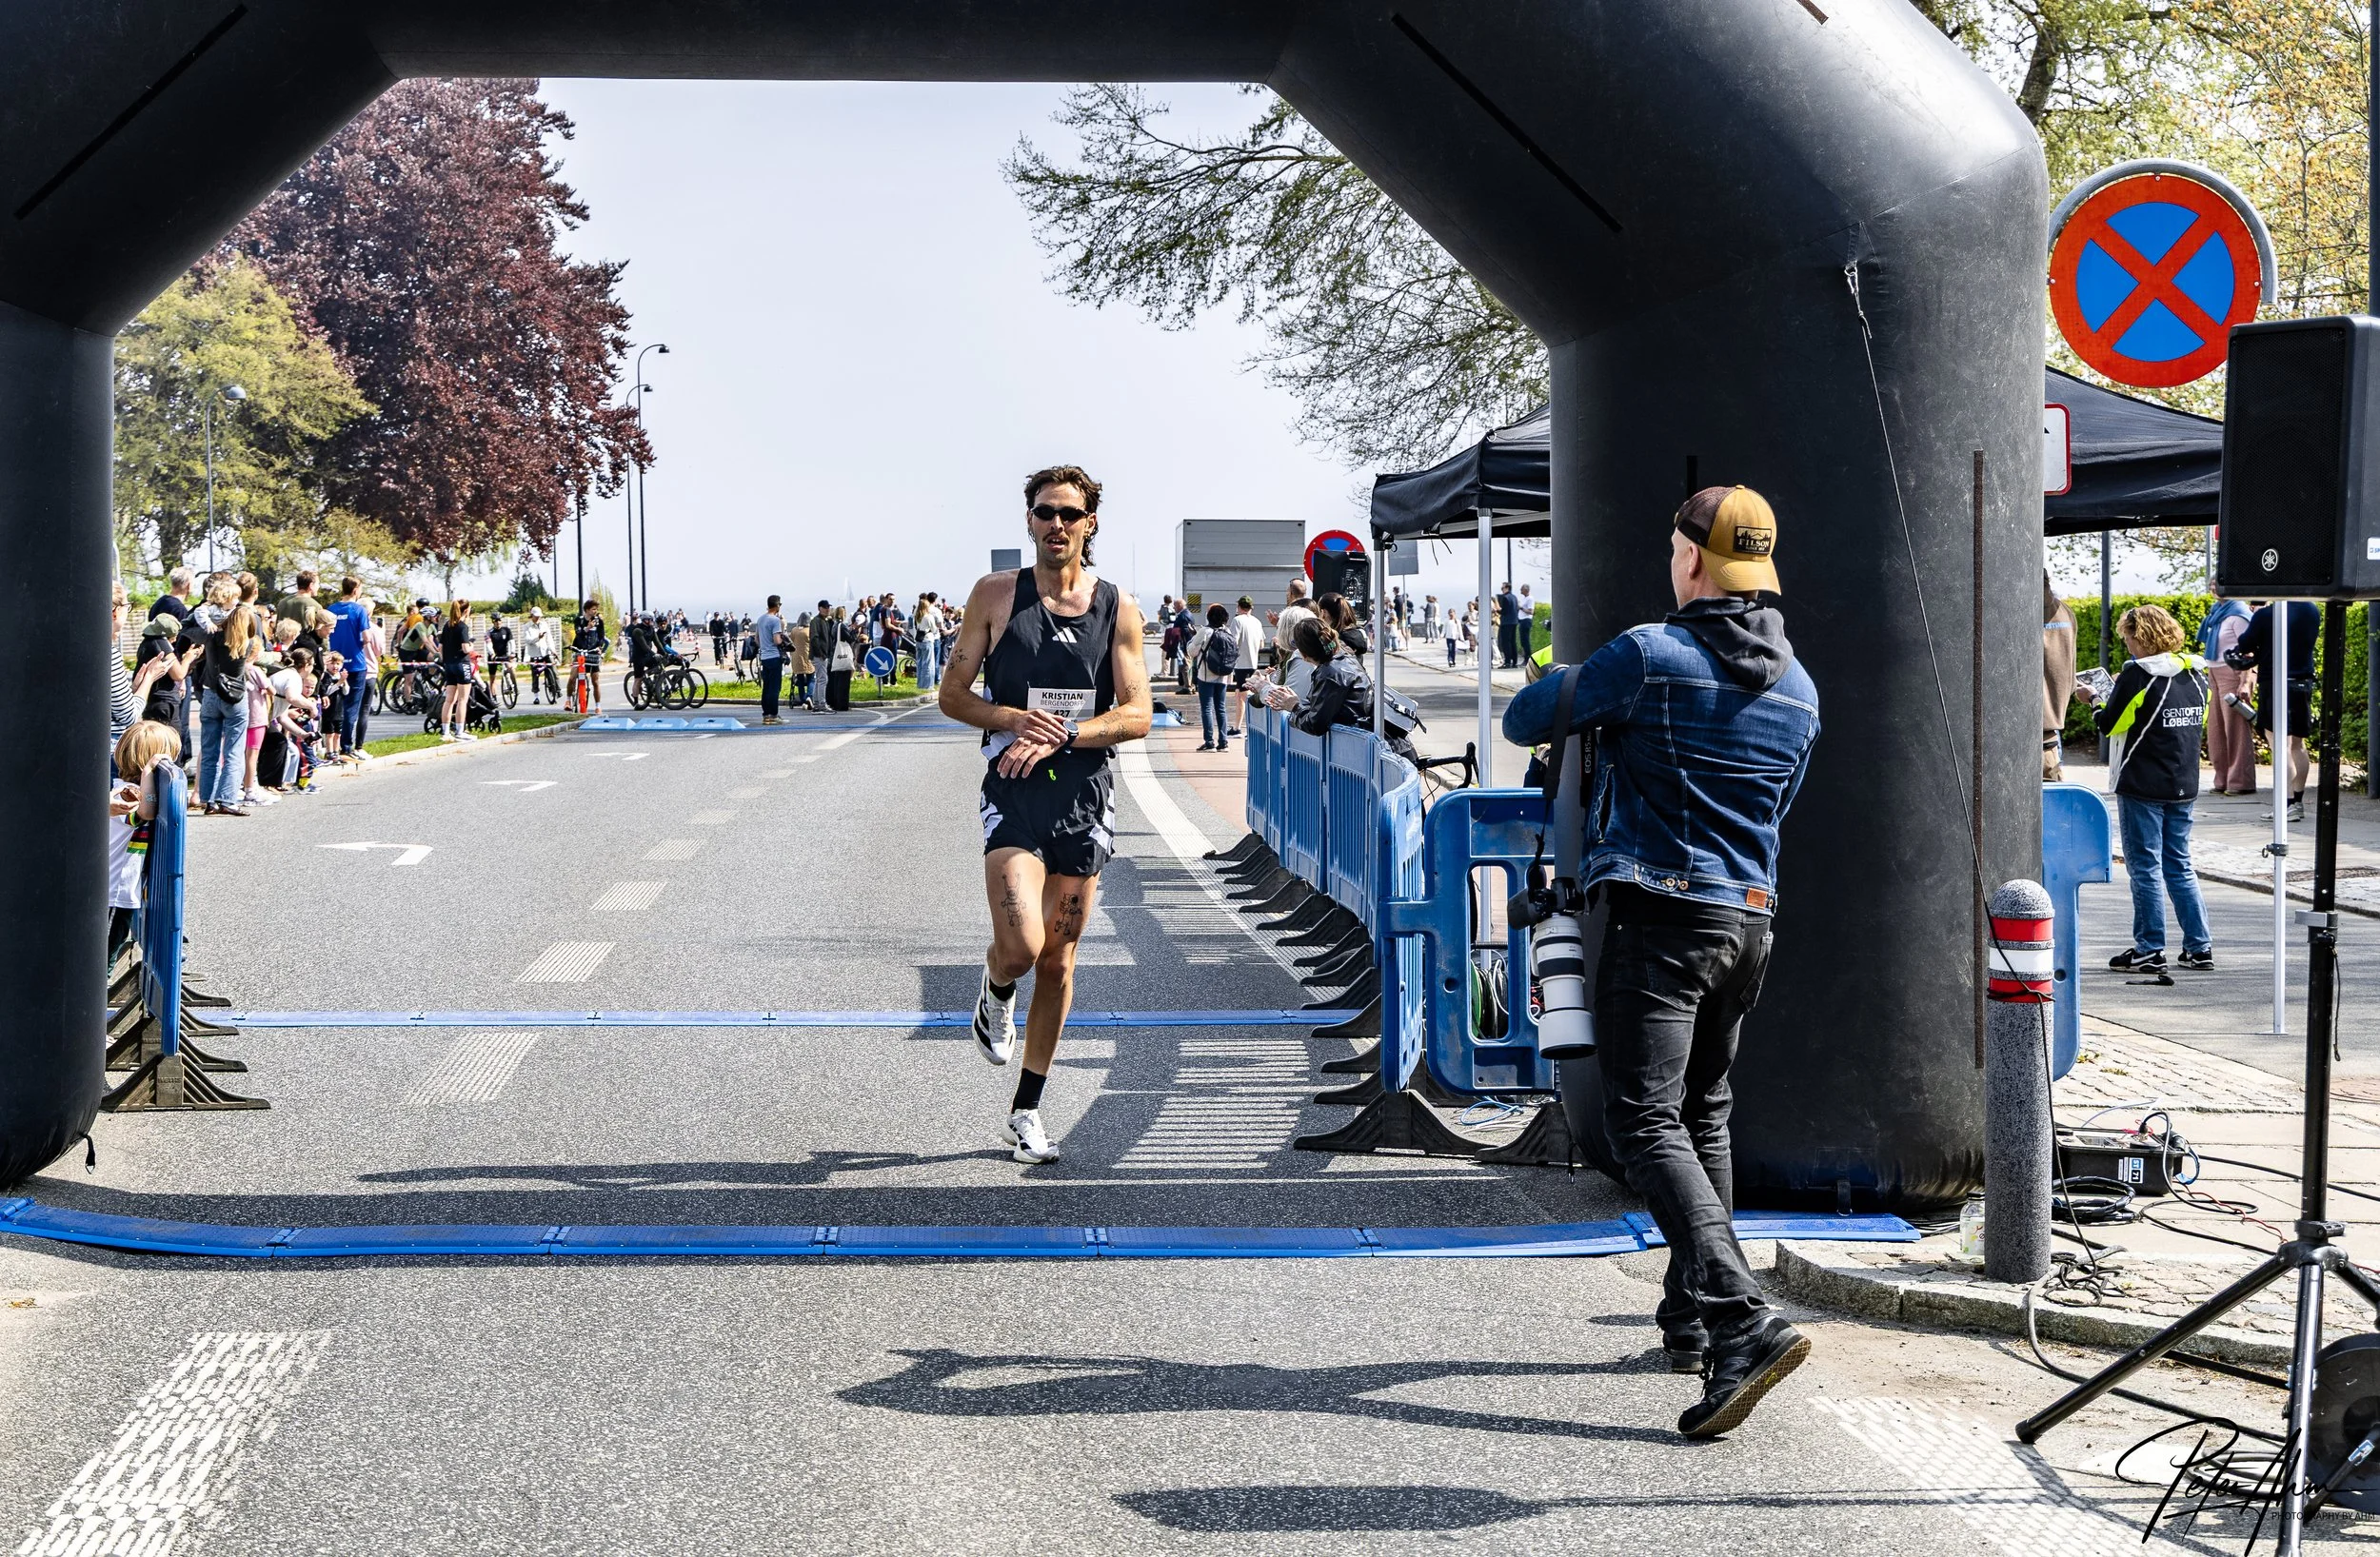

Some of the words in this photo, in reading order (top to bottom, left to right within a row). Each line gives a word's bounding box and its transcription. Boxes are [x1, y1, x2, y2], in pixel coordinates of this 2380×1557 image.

[1738, 539, 1770, 548] FILSON
[1041, 691, 1083, 700] KRISTIAN
[1053, 709, 1071, 718] 427
[2162, 706, 2203, 719] GENTOFTE
[2162, 716, 2203, 728] LØBEKLUB
[2132, 1172, 2139, 1180] 71
